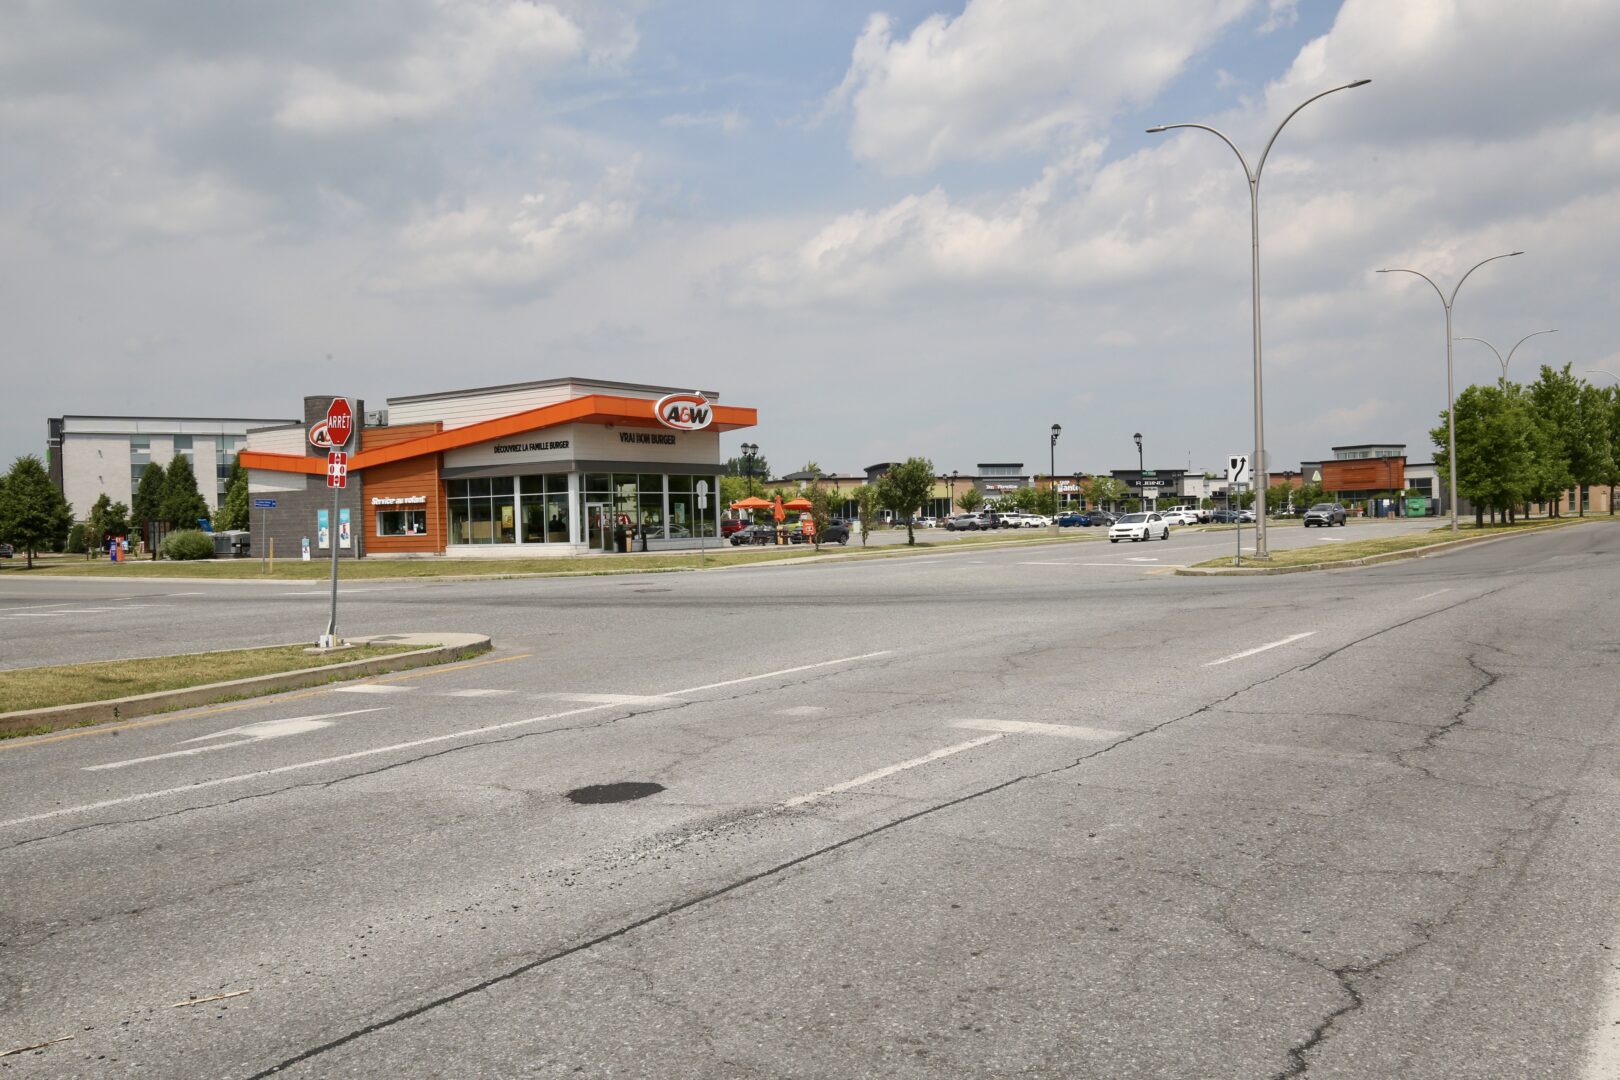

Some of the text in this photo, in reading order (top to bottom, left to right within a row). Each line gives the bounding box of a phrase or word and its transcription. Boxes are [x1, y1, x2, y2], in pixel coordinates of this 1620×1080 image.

[328, 413, 350, 429] ARRÊT
[667, 405, 708, 424] A&W
[620, 432, 635, 443] VRAI
[651, 434, 676, 445] BURGER
[494, 444, 522, 453] DÉCOUVREZ
[530, 442, 548, 451] FAMILLE
[550, 441, 569, 449] BURGER
